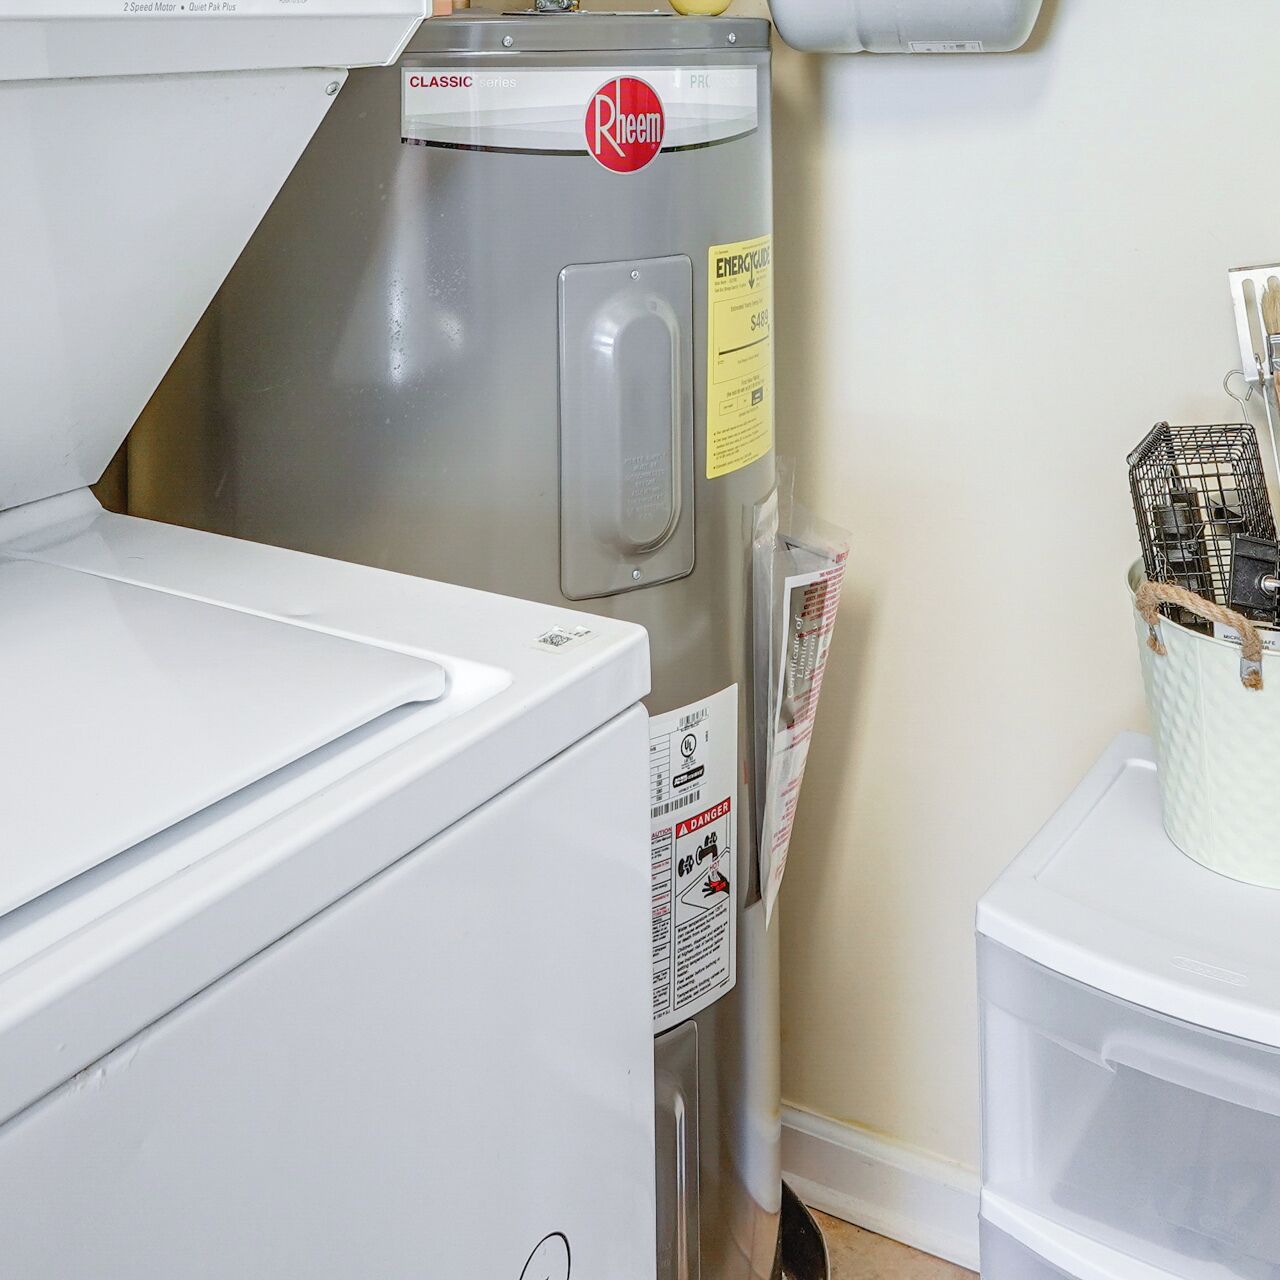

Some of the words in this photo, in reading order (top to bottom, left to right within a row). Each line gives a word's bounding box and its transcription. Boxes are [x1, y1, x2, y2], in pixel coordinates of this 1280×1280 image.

[123, 2, 128, 12] 2
[129, 2, 154, 13] Speed
[154, 2, 176, 12] Motor
[188, 2, 207, 12] Quiet
[208, 2, 220, 12] Pak
[222, 2, 236, 12] Plus
[409, 75, 474, 88] CLASSIC
[478, 75, 517, 88] series
[592, 76, 662, 158] Rheem
[786, 632, 800, 698] Certificate
[794, 614, 804, 630] of
[690, 800, 730, 831] DANGER
[650, 826, 672, 839] AUTION
[709, 860, 720, 872] HOT
